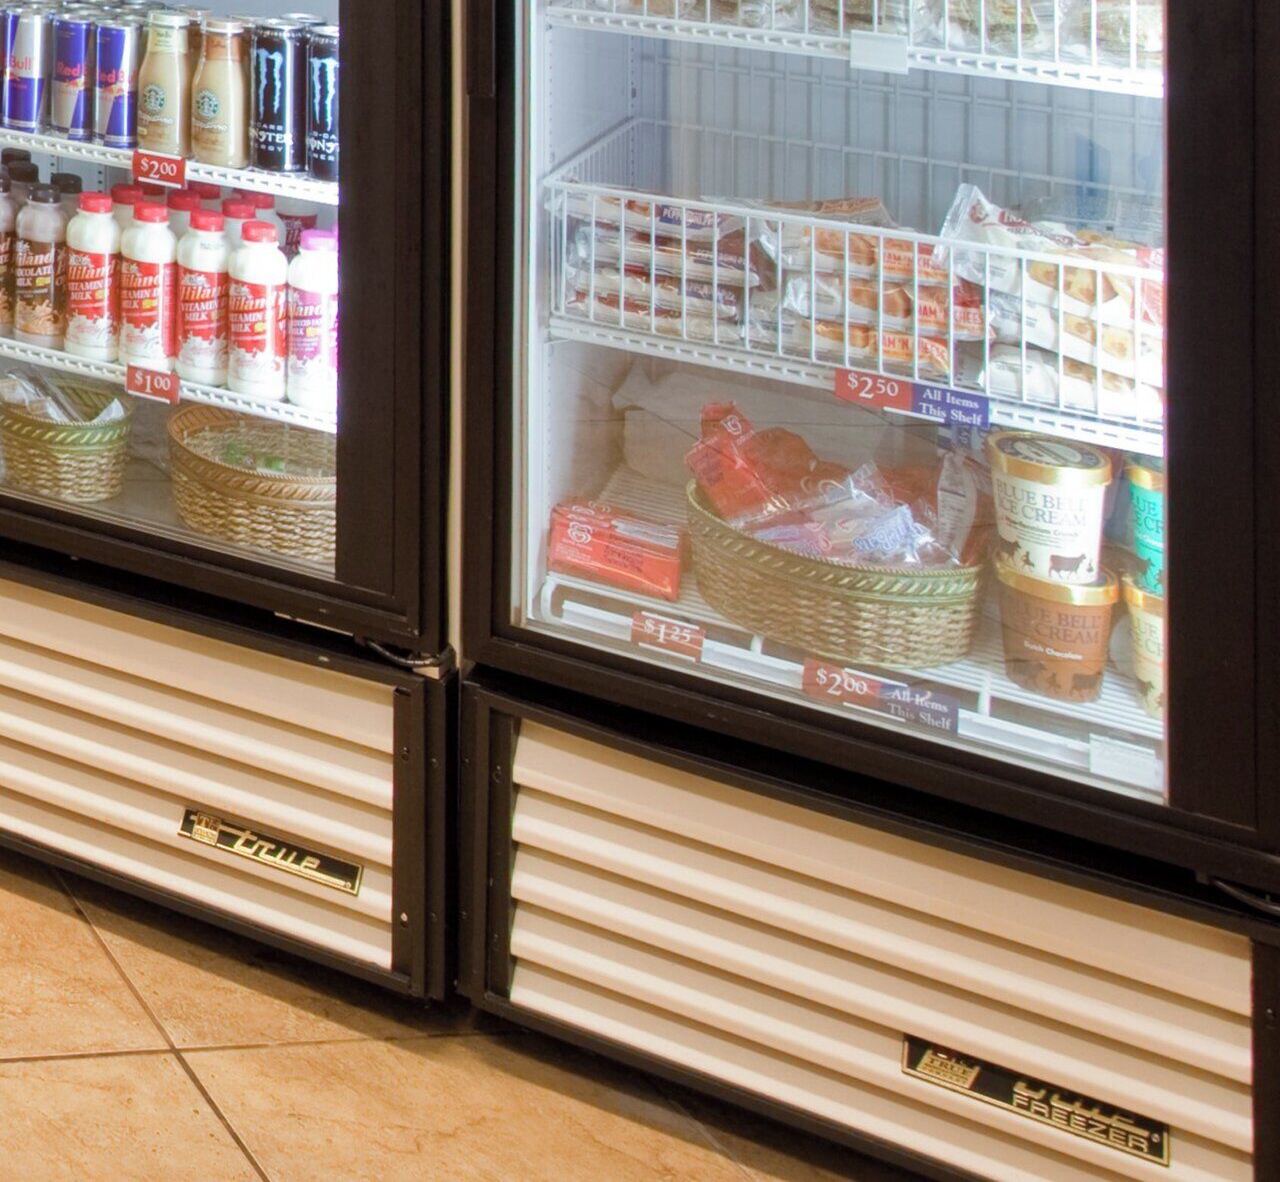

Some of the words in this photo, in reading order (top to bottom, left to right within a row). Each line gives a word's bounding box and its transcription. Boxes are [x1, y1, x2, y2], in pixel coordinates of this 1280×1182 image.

[71, 290, 92, 300] MILK
[185, 312, 208, 322] MILK
[923, 388, 941, 402] All
[947, 394, 980, 410] Items
[919, 401, 945, 417] This
[950, 409, 982, 428] Shelf
[996, 477, 1038, 506] BLUE
[1042, 493, 1087, 511] BELL
[999, 498, 1020, 516] ICE
[1021, 505, 1086, 527] CREAM
[1057, 612, 1100, 630] BELL
[1045, 647, 1084, 661] Chocolate
[890, 687, 912, 704] All
[913, 692, 949, 714] Items
[887, 703, 917, 722] This
[919, 711, 953, 731] Shelf
[1012, 1093, 1150, 1154] FREEZER
